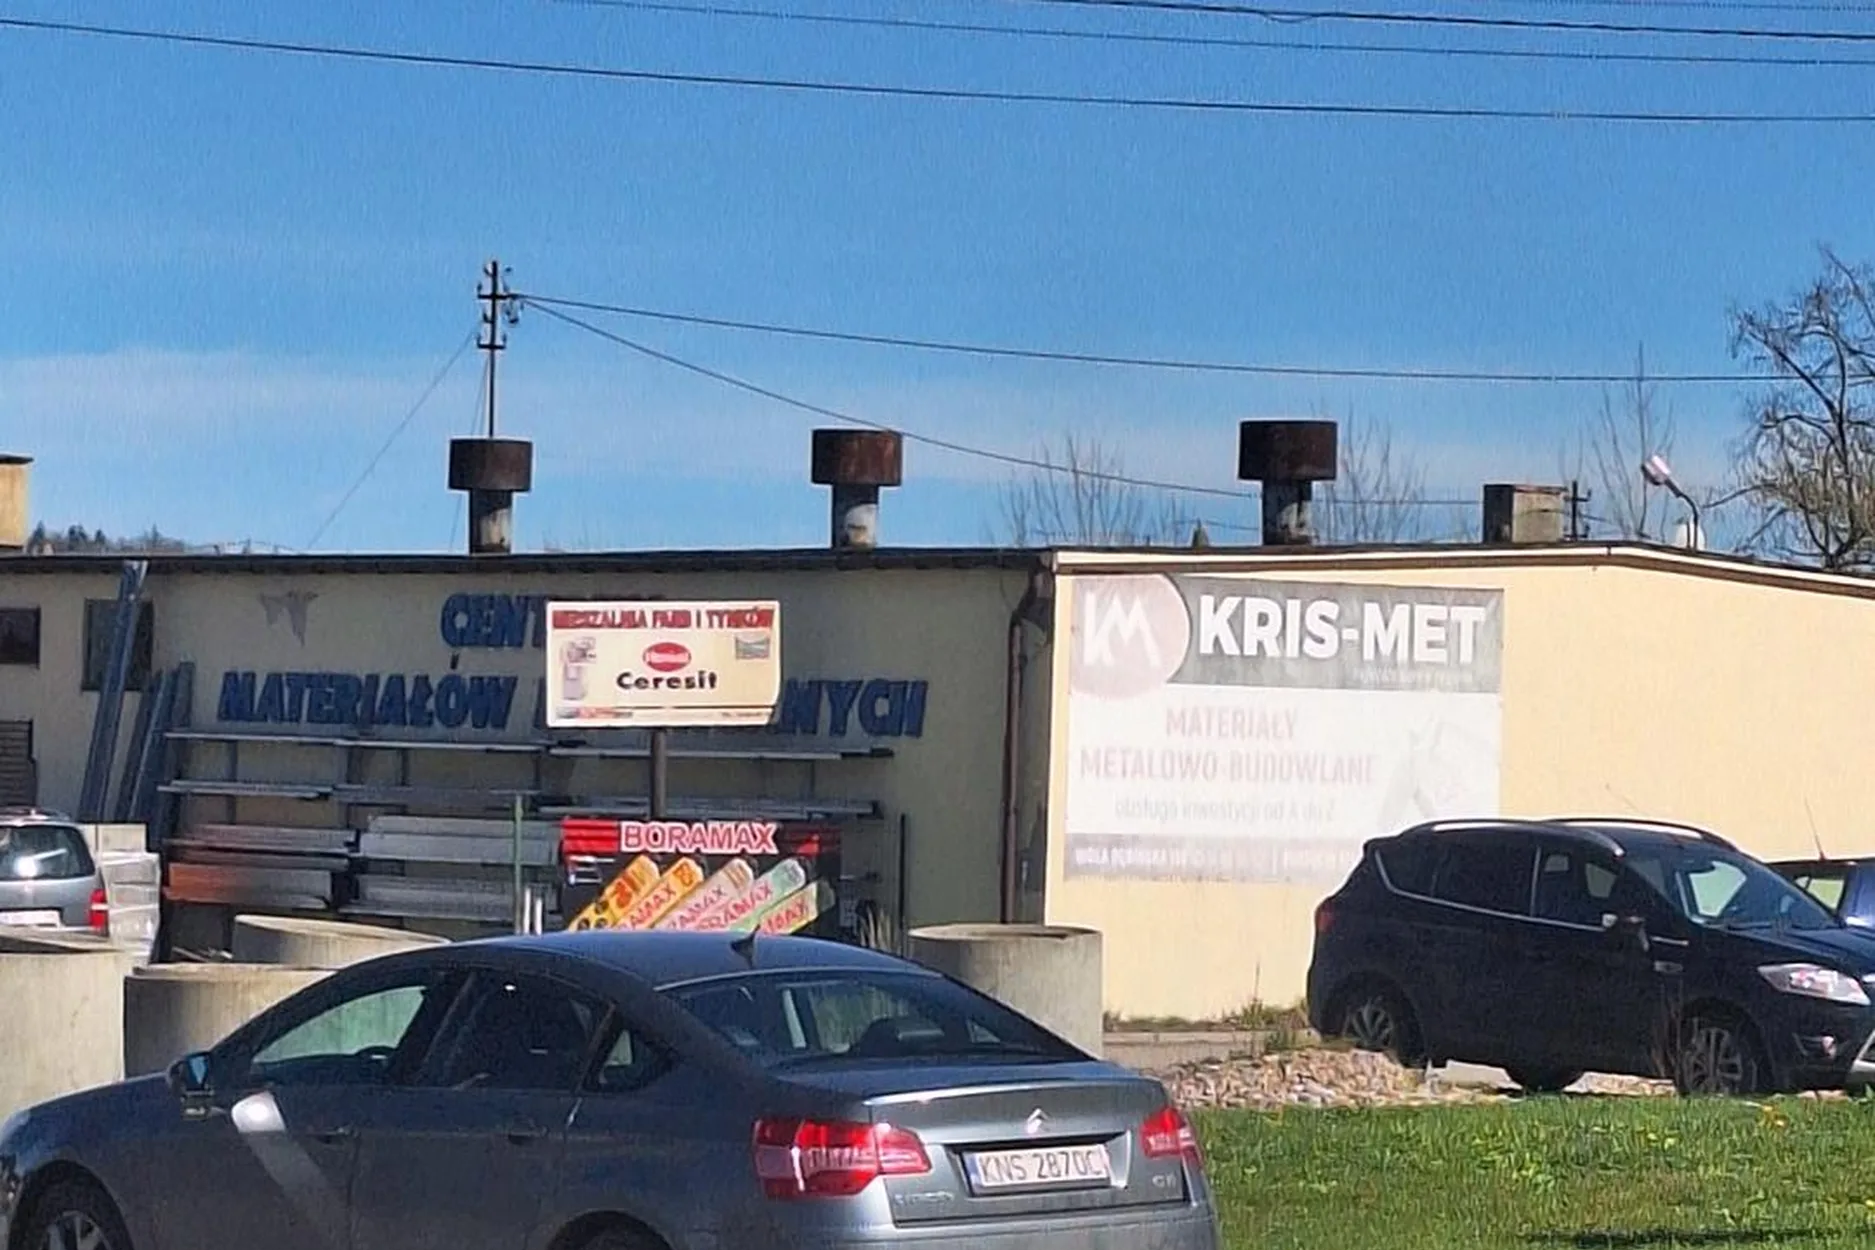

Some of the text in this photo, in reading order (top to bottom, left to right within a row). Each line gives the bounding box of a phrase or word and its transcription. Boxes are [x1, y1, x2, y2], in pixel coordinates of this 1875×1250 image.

[1199, 594, 1487, 664] KRIS-MET
[217, 653, 518, 730] MATERIAŁÓW
[616, 670, 718, 690] Ceresit
[1165, 706, 1298, 741] MATERIAŁY
[622, 822, 778, 854] BORAMAX
[979, 1154, 1027, 1182] KNS
